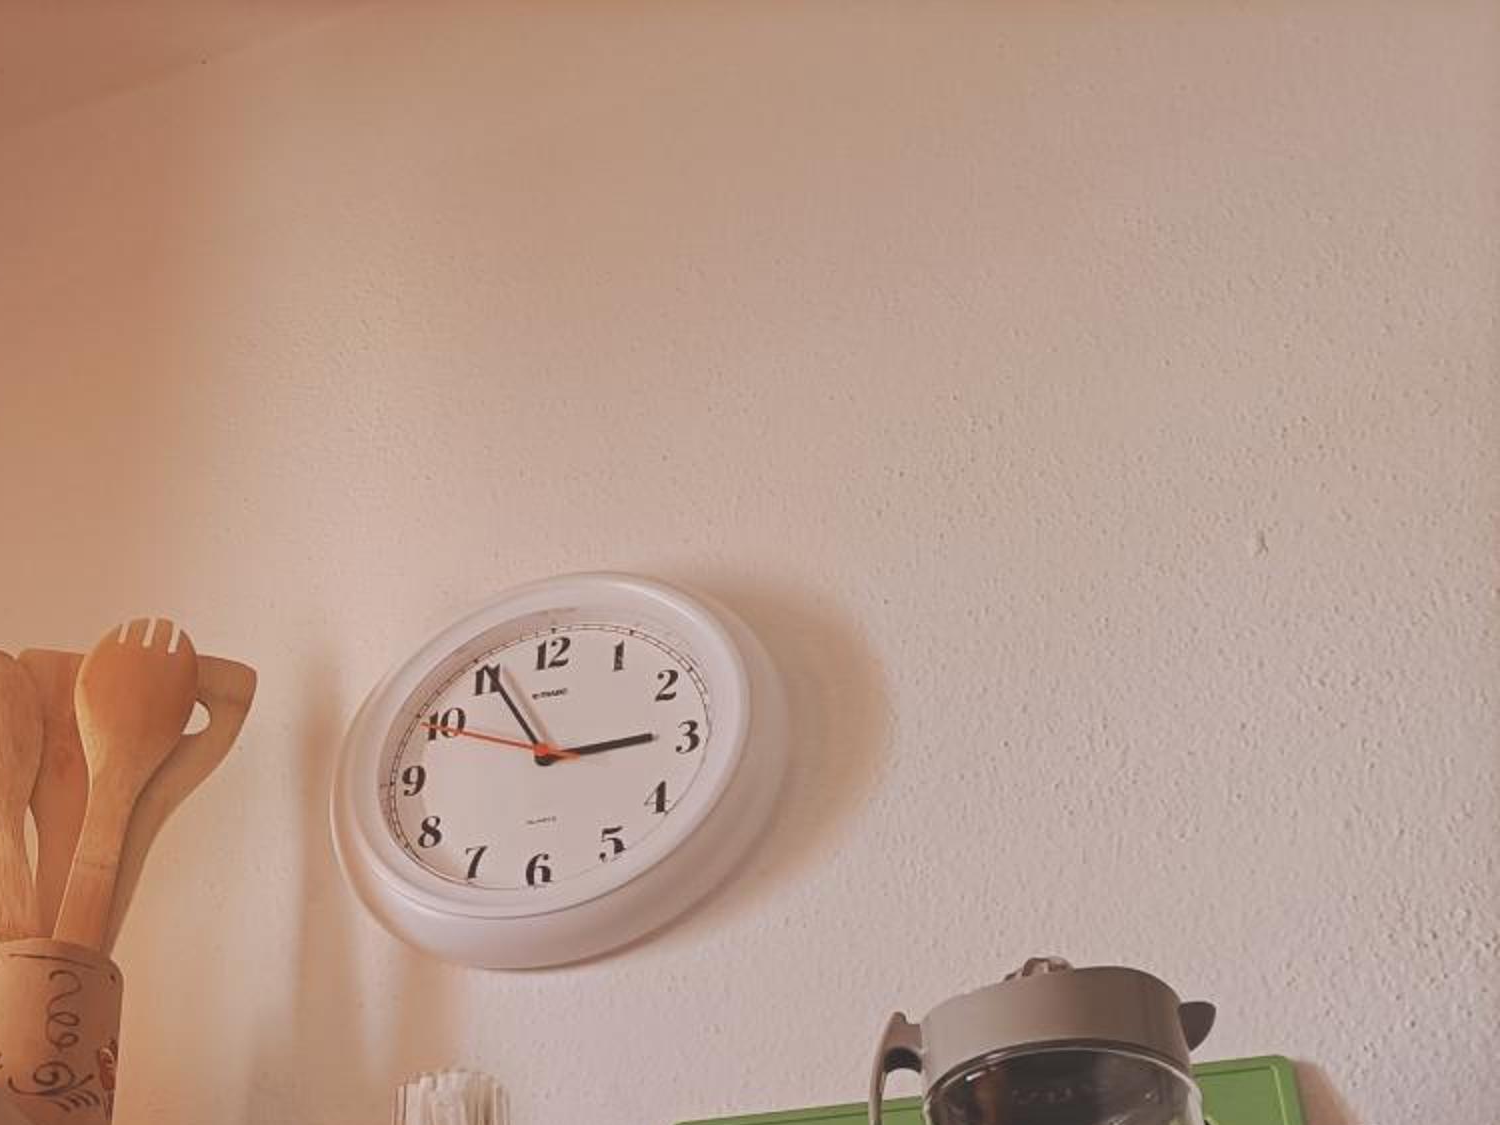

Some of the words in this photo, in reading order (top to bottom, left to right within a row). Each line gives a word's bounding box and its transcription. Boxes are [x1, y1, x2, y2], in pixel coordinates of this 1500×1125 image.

[534, 637, 571, 671] 12
[612, 640, 625, 671] 1
[655, 669, 679, 701] 2
[426, 706, 467, 742] 10
[675, 719, 700, 755] 3
[402, 764, 426, 797] 9
[644, 780, 669, 814] 4
[417, 815, 443, 849] 8
[600, 826, 626, 862] 5
[465, 845, 488, 879] 7
[525, 852, 552, 886] 6
